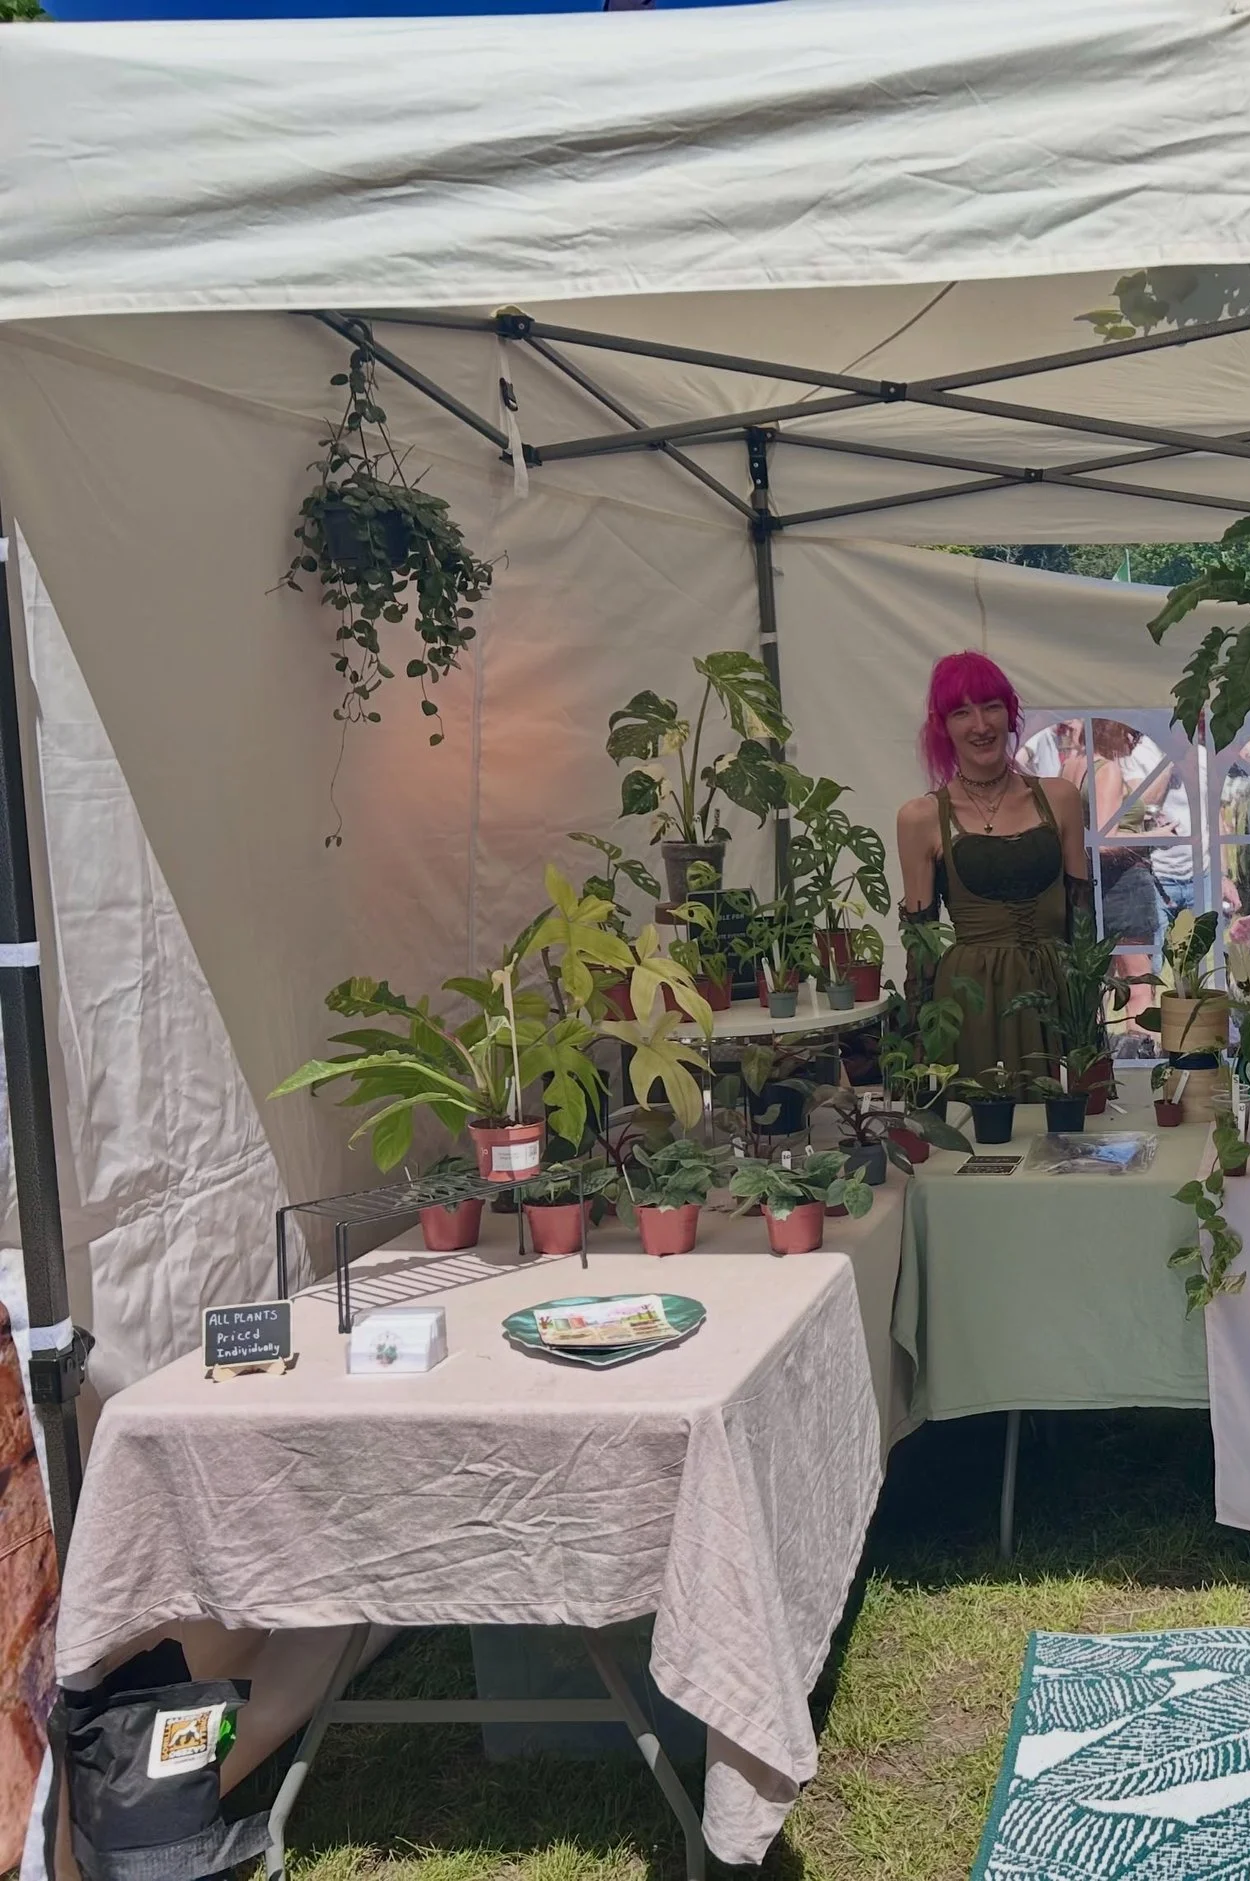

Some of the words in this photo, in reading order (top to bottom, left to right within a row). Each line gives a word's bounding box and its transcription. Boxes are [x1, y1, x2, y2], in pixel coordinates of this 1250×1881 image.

[209, 1313, 228, 1326] ALL
[234, 1309, 278, 1323] PLANTS
[216, 1343, 280, 1359] Individually
